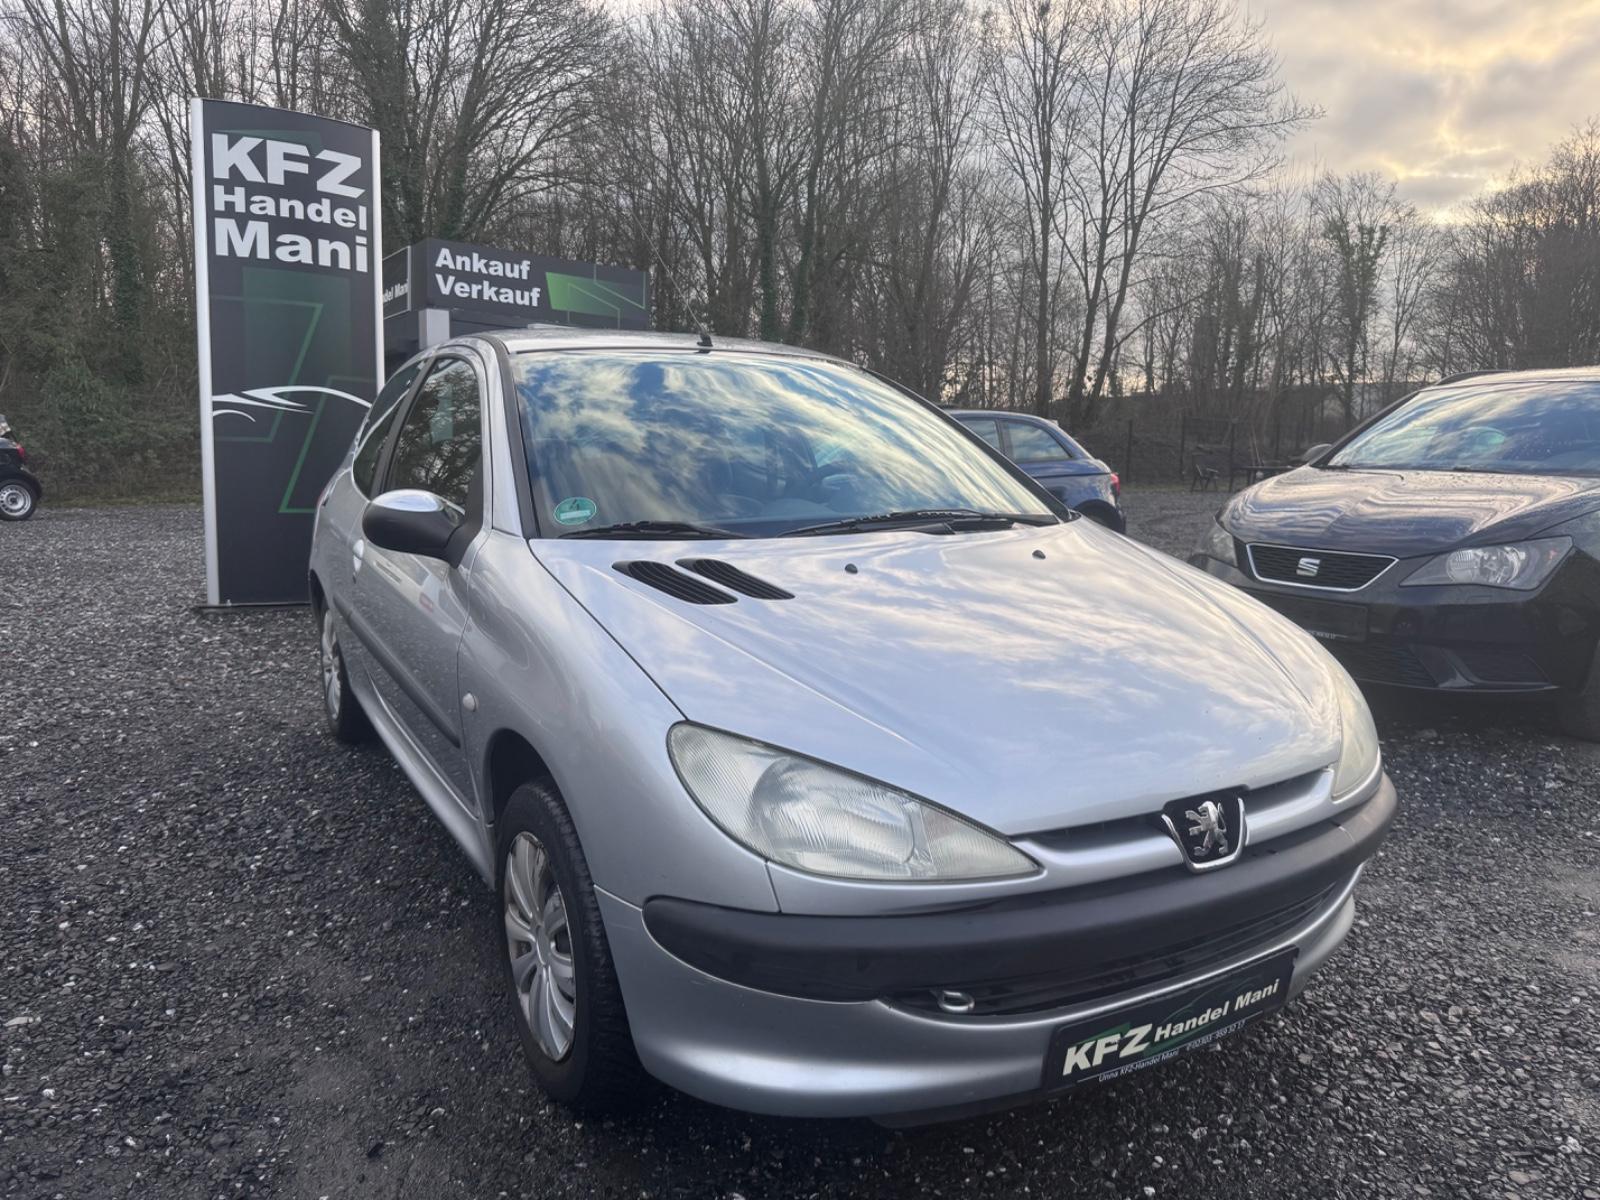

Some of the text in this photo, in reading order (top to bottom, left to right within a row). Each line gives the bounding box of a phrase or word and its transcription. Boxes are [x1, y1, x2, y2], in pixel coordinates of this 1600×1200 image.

[212, 133, 366, 199] KFZ
[213, 184, 368, 232] Handel
[214, 217, 368, 273] Mani
[435, 247, 531, 280] Ankauf
[435, 273, 541, 307] Verkauf
[1062, 1023, 1153, 1076] KFZ
[1154, 1000, 1230, 1043] Handel
[1234, 978, 1280, 1011] Mani
